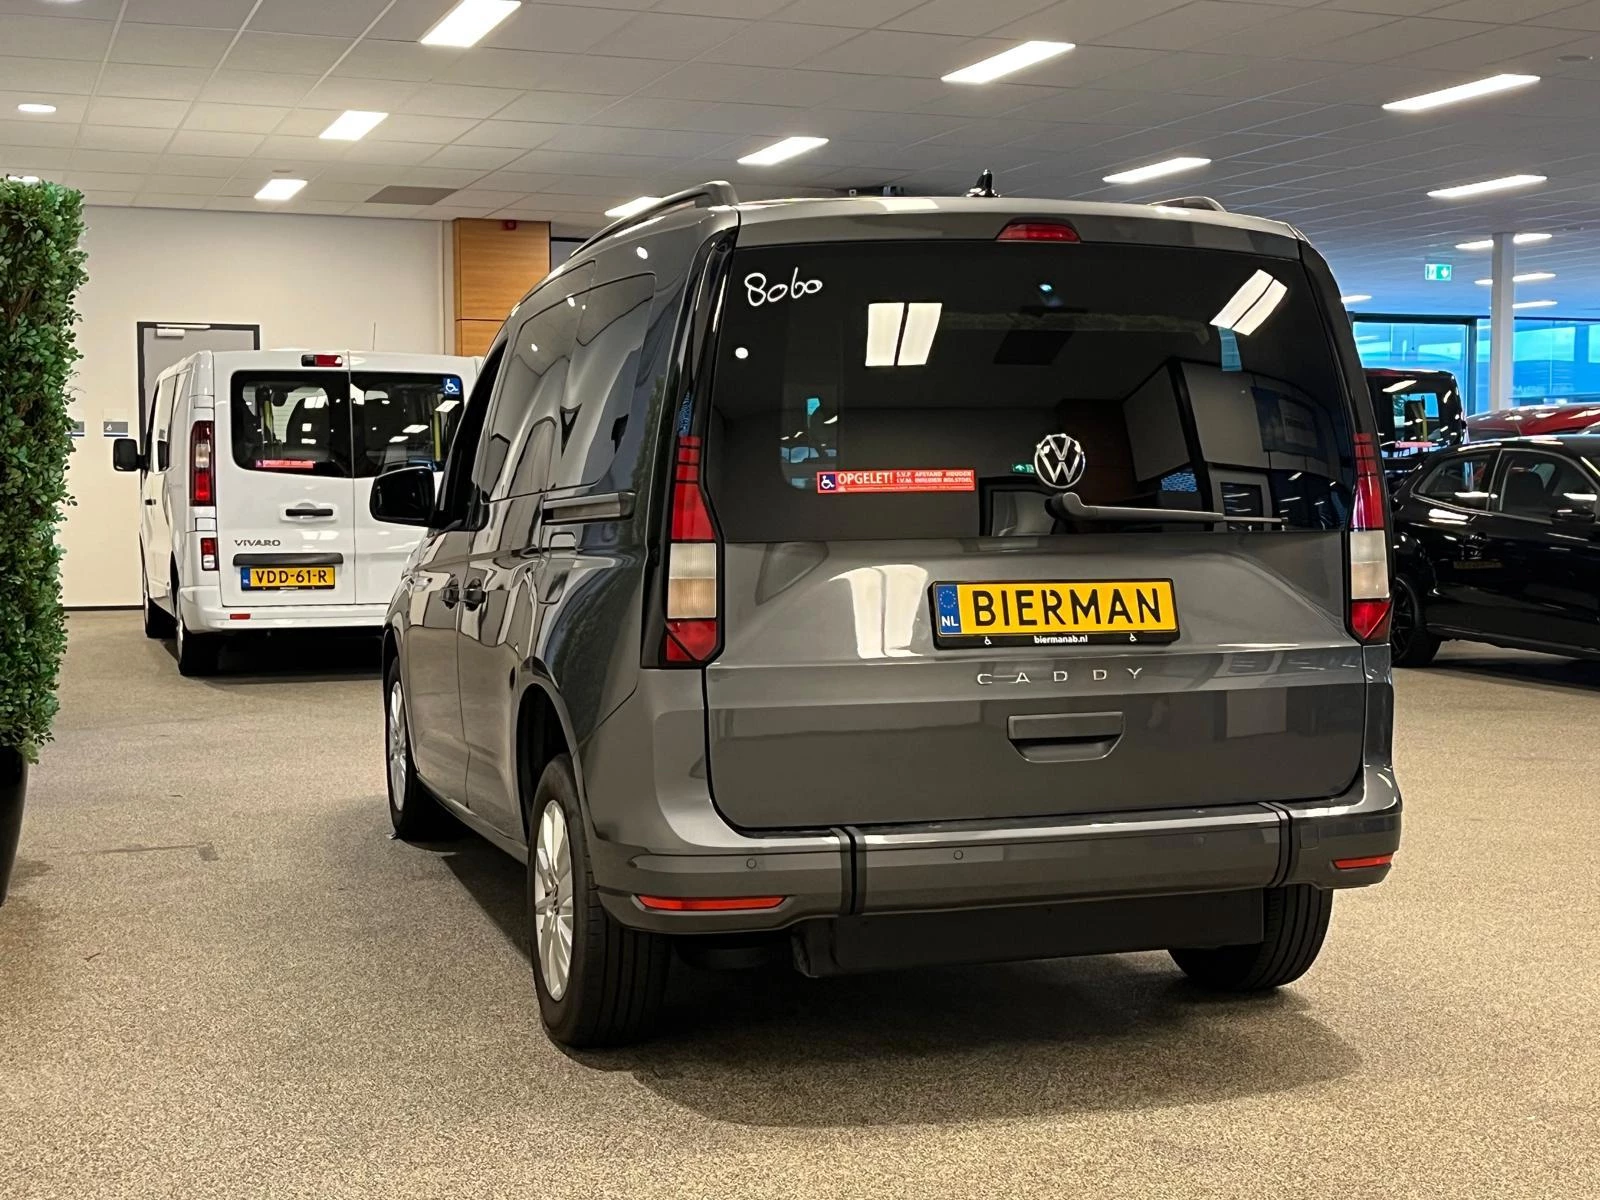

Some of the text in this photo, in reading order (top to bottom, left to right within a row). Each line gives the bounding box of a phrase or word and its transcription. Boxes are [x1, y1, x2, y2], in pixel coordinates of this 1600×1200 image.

[838, 471, 893, 485] OPGELET!
[234, 539, 281, 547] VIVARO
[255, 569, 328, 585] VDD-61-R
[941, 588, 1162, 627] NL BIERMAN
[1033, 634, 1089, 644] biermanab.nl
[976, 667, 1143, 685] CADDY
